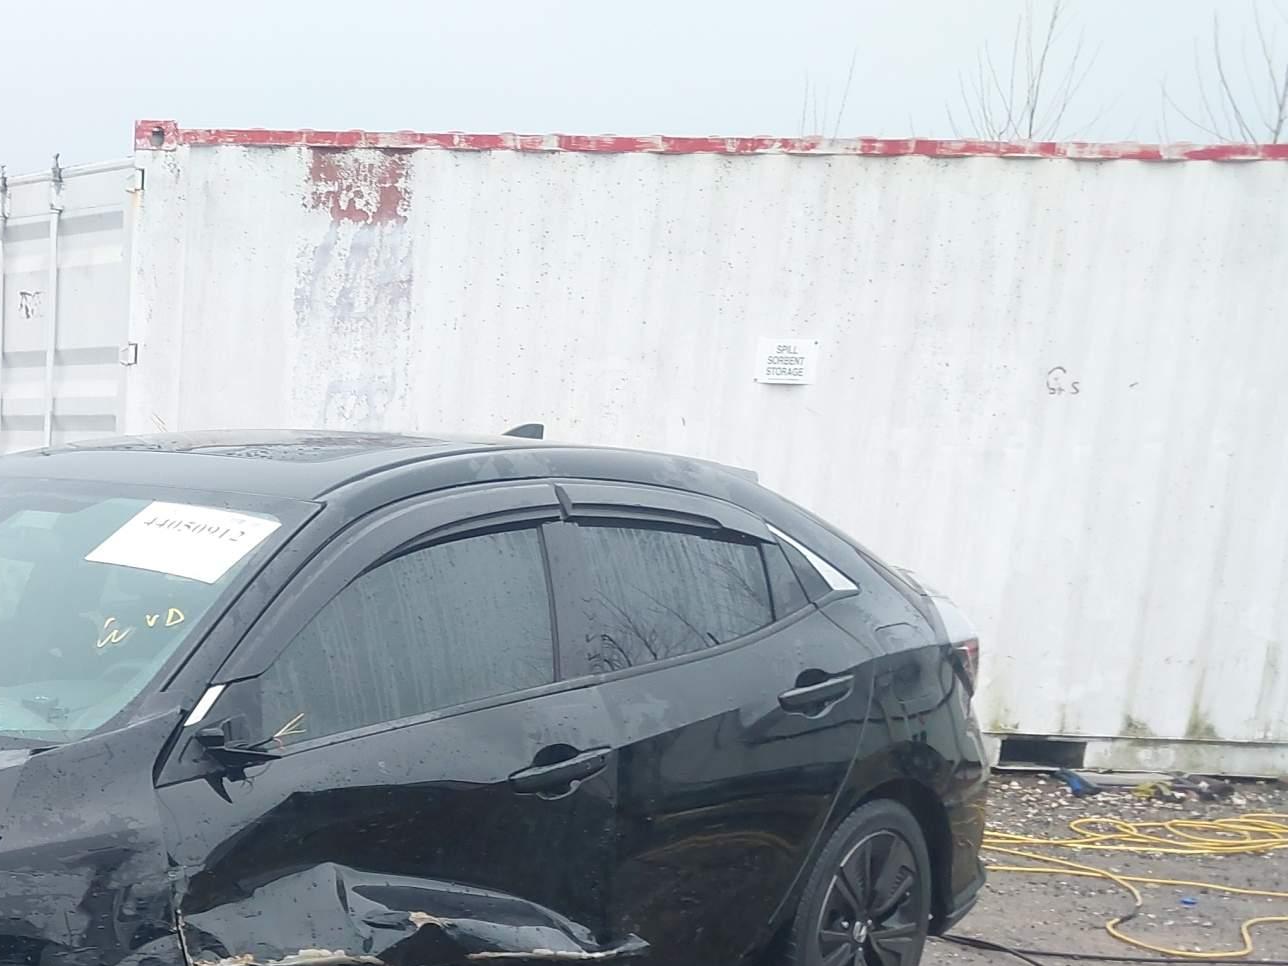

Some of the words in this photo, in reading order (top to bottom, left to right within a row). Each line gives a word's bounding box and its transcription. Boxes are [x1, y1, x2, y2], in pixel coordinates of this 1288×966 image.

[776, 345, 799, 354] SPILL
[767, 355, 805, 365] SORBENT
[766, 367, 804, 376] STORAGE
